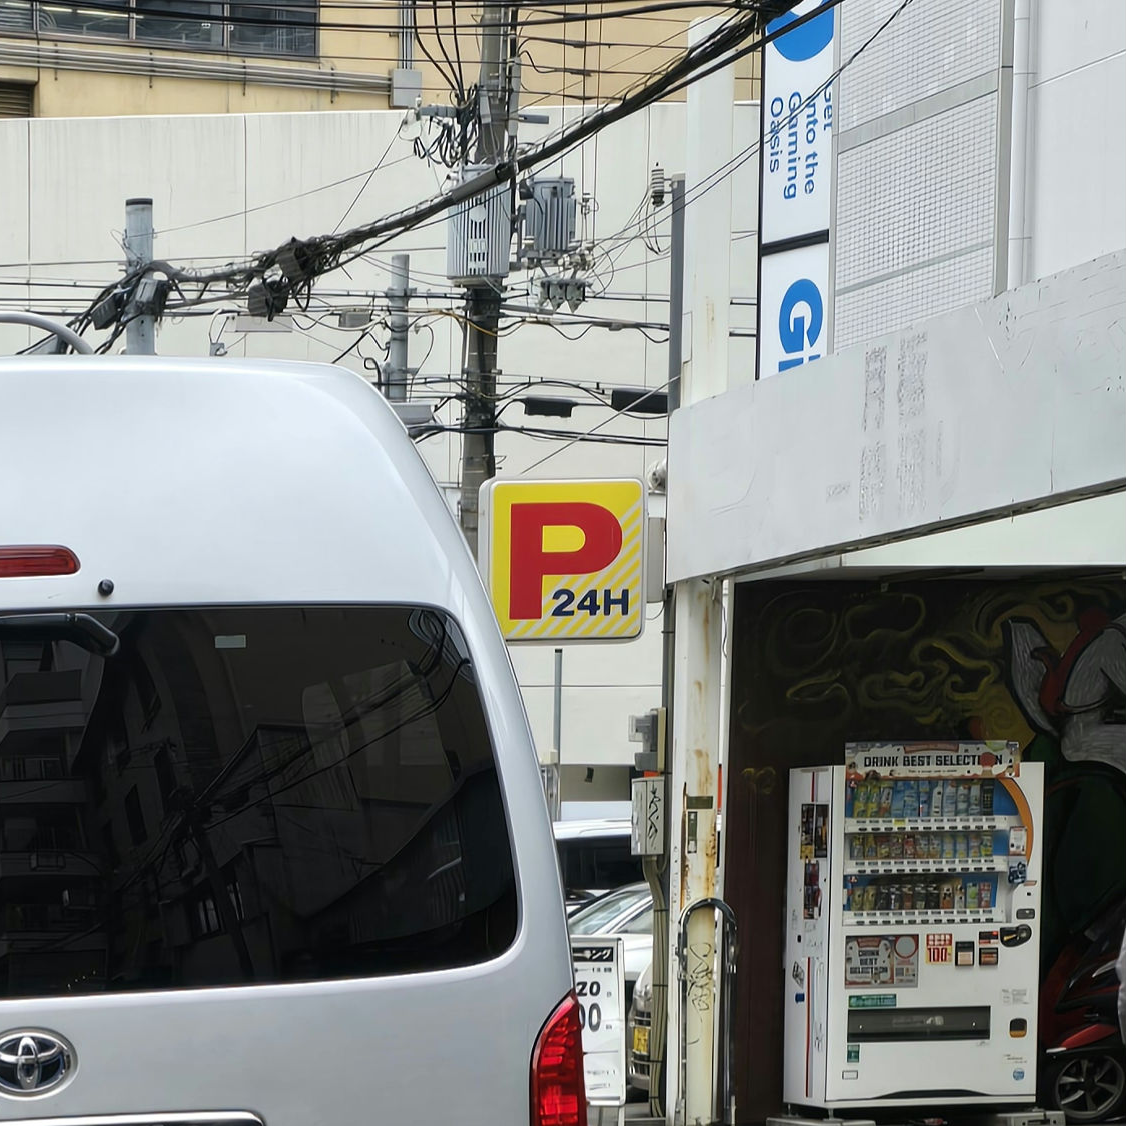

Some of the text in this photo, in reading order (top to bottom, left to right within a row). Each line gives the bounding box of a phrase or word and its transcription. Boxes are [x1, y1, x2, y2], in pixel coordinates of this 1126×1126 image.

[770, 97, 783, 173] Oasis
[784, 92, 802, 199] Gaming
[805, 152, 818, 194] the
[509, 502, 623, 620] P
[552, 589, 629, 617] 24H
[864, 754, 1003, 767] DRINK BEST SELECTIN
